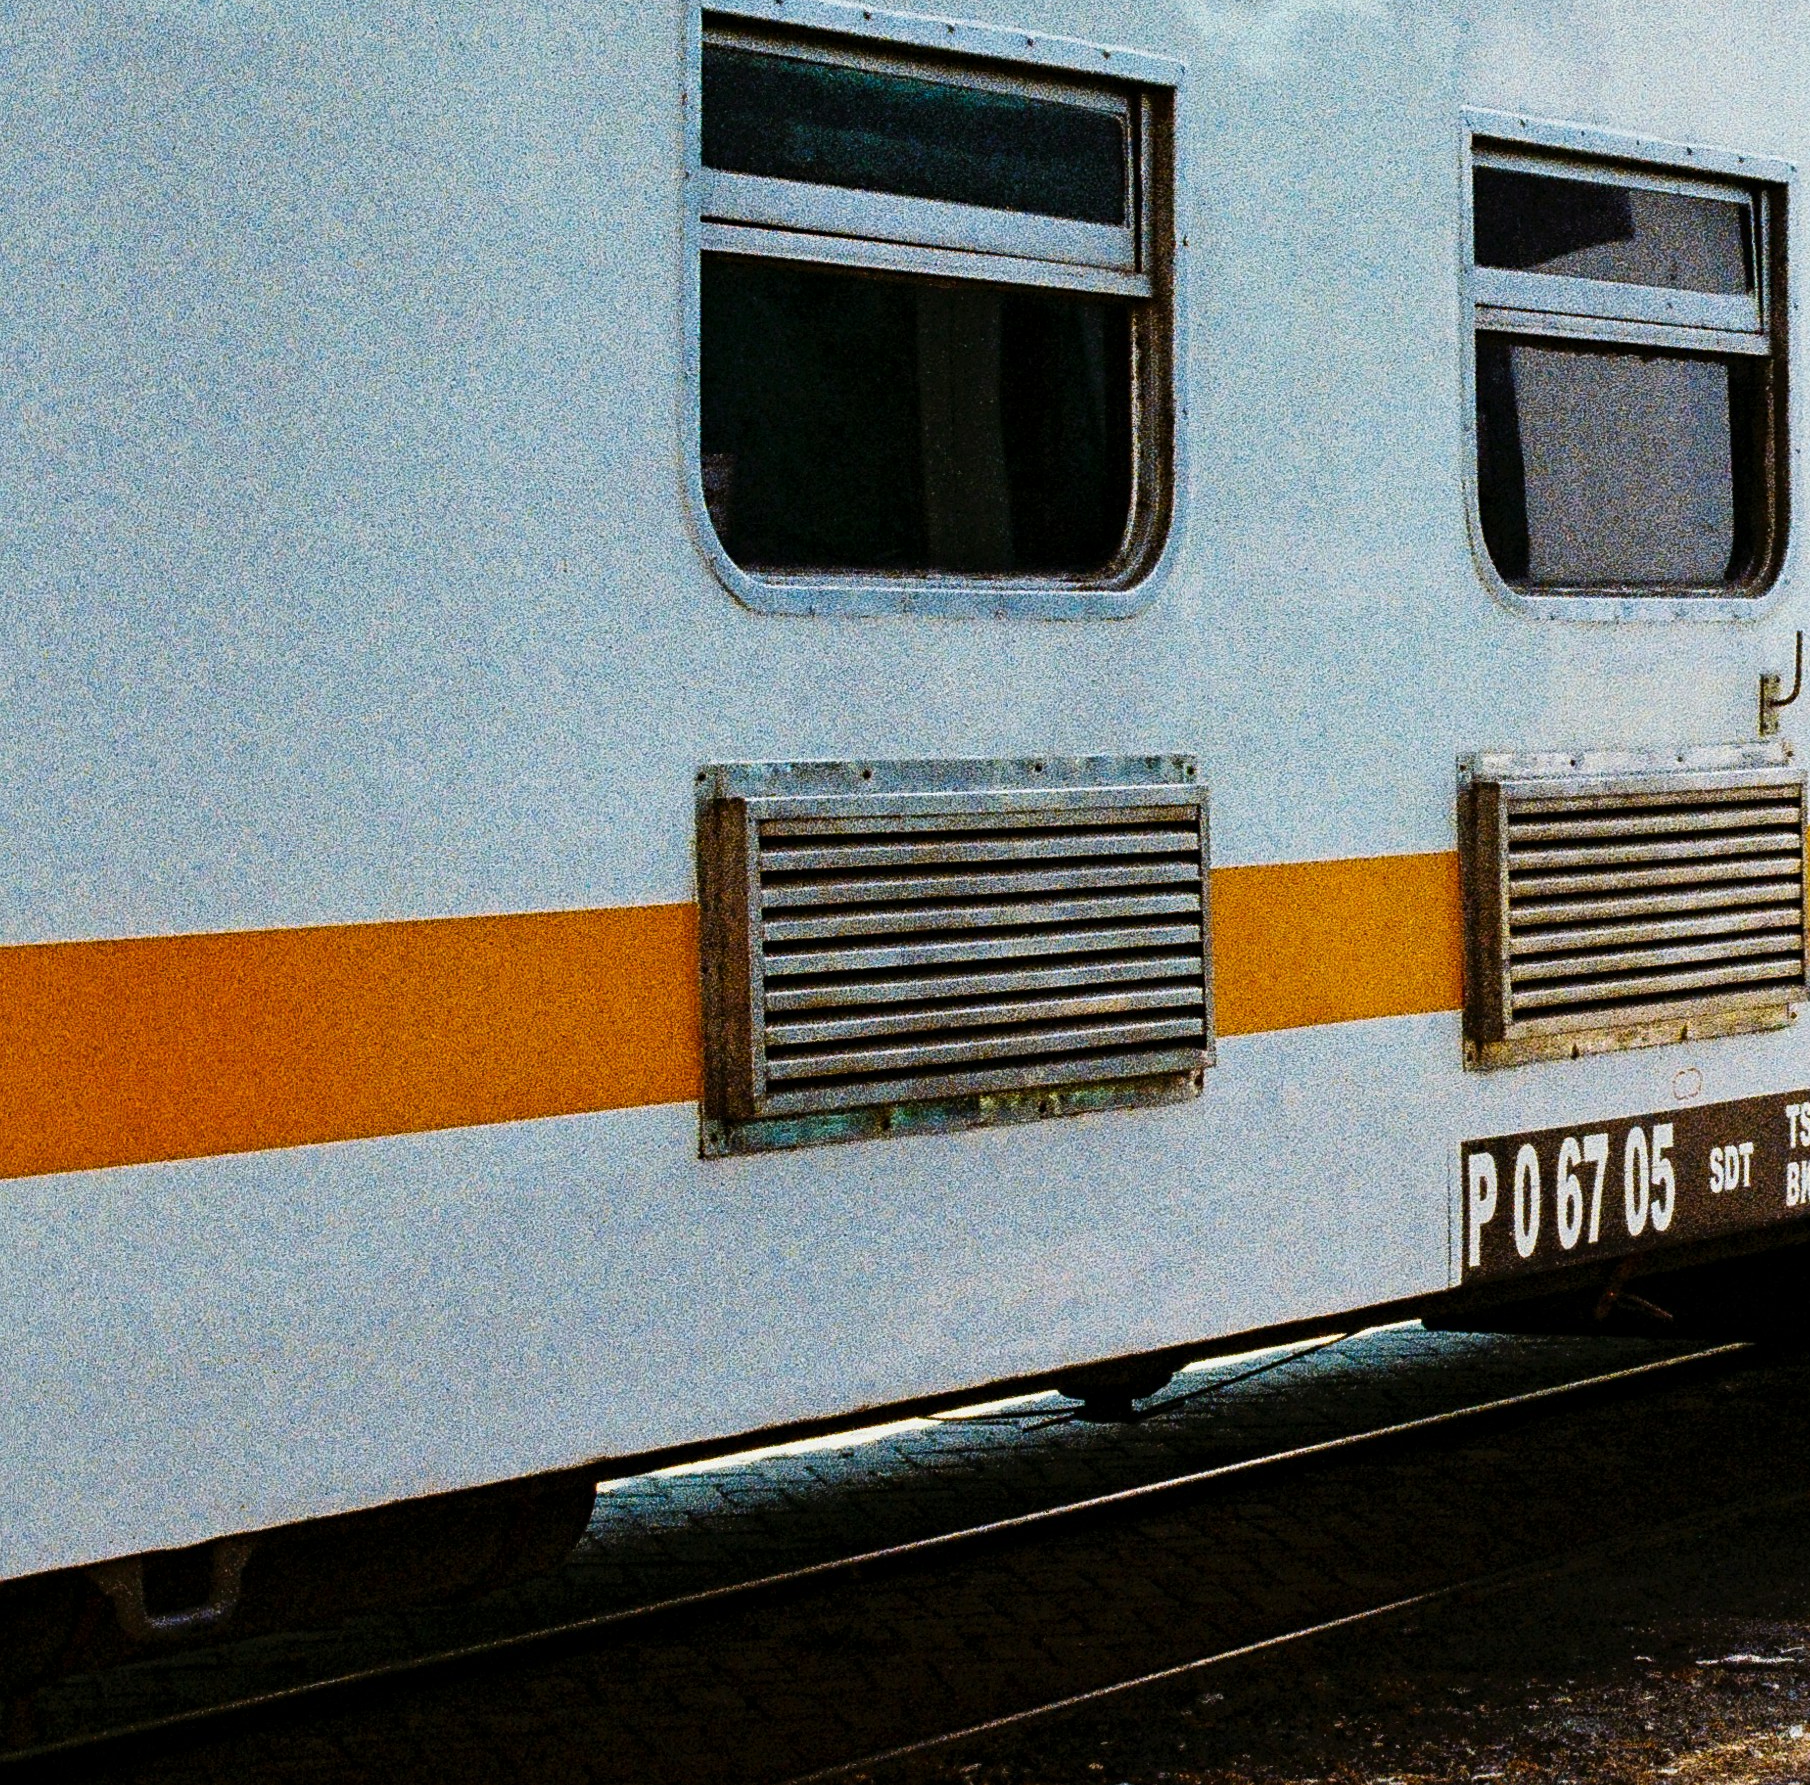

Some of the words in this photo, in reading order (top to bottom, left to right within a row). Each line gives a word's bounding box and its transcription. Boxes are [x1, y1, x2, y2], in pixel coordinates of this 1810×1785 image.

[1469, 1152, 1498, 1267] P
[1557, 1133, 1608, 1250] 67
[1624, 1123, 1676, 1237] 05
[1710, 1142, 1754, 1194] SDT
